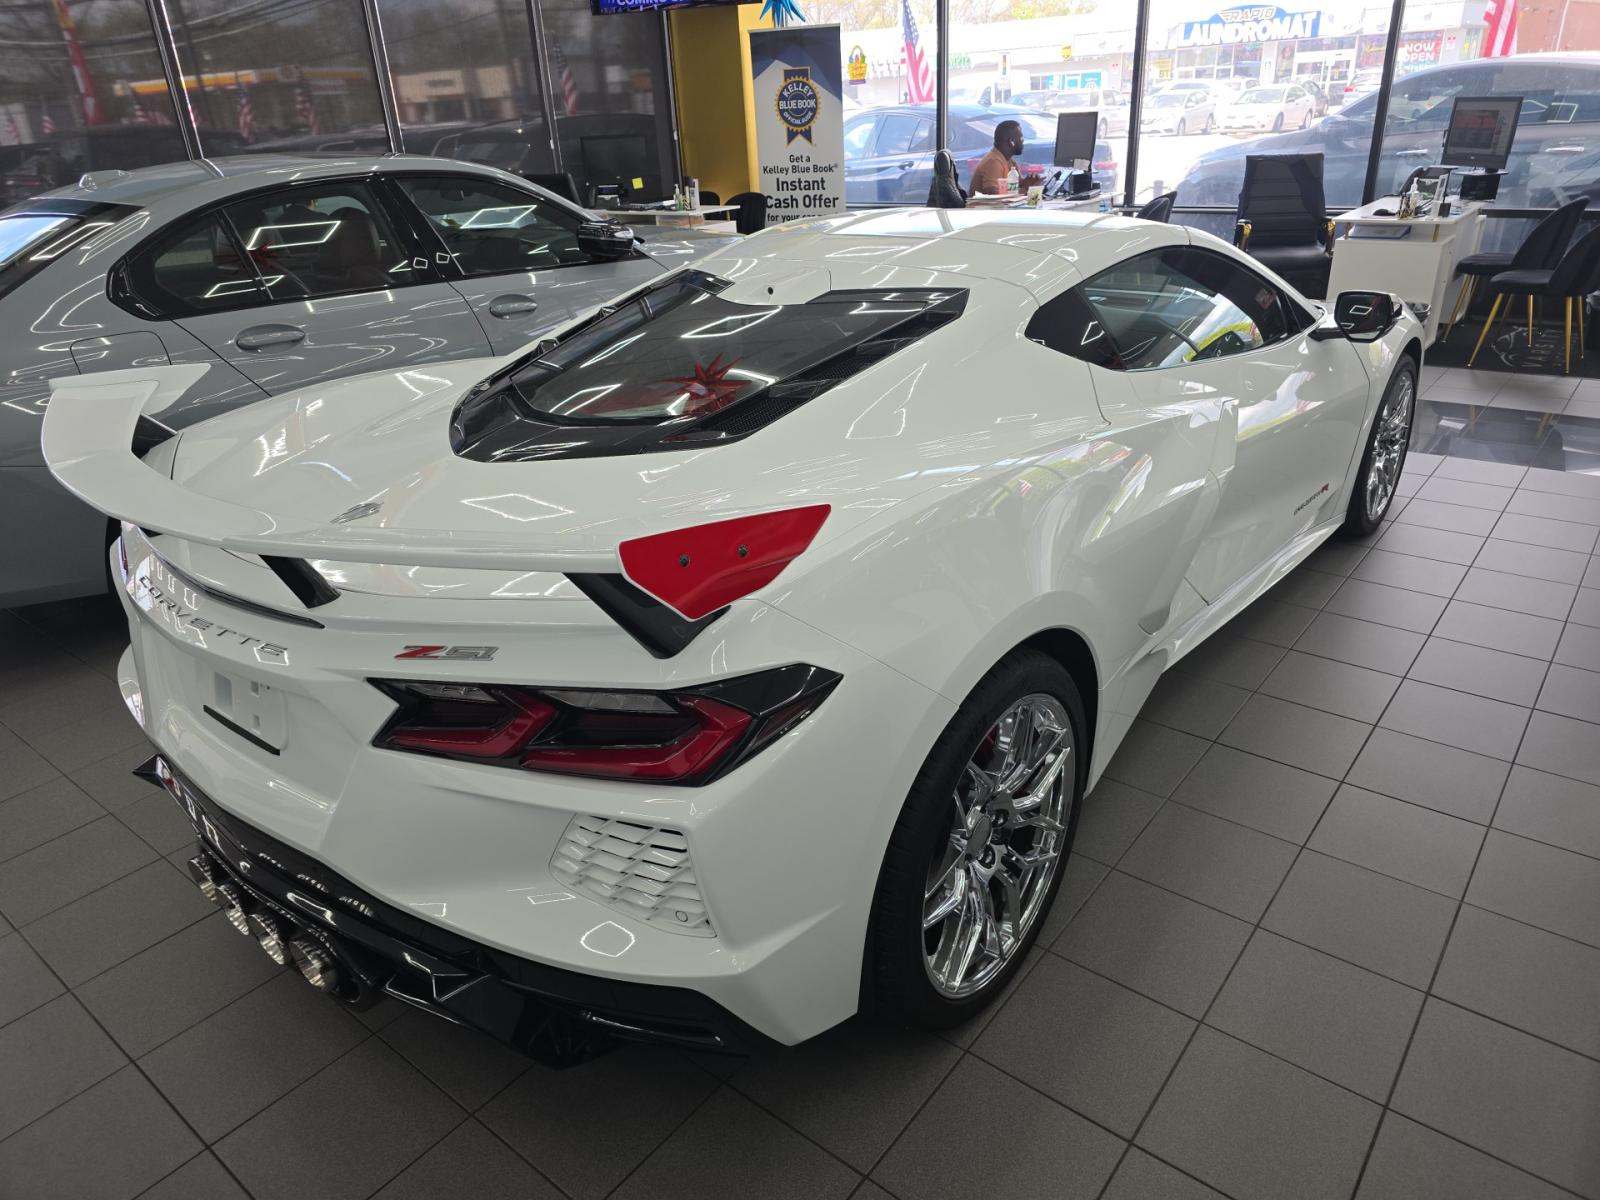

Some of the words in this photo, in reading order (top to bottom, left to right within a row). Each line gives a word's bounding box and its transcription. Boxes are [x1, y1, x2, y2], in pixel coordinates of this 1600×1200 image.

[1177, 11, 1317, 48] LAUNDROMAT
[782, 82, 814, 98] KELLEY
[780, 100, 797, 109] BLUE
[797, 98, 816, 108] BOOK
[789, 154, 804, 163] Get
[763, 165, 789, 175] Kelley
[791, 164, 811, 173] Blue
[776, 177, 826, 191] Instant
[766, 194, 799, 208] Cash
[802, 194, 839, 208] Offer
[767, 213, 780, 222] for
[781, 214, 800, 223] your
[139, 575, 288, 656] CORVETTE
[394, 645, 500, 661] Z51
